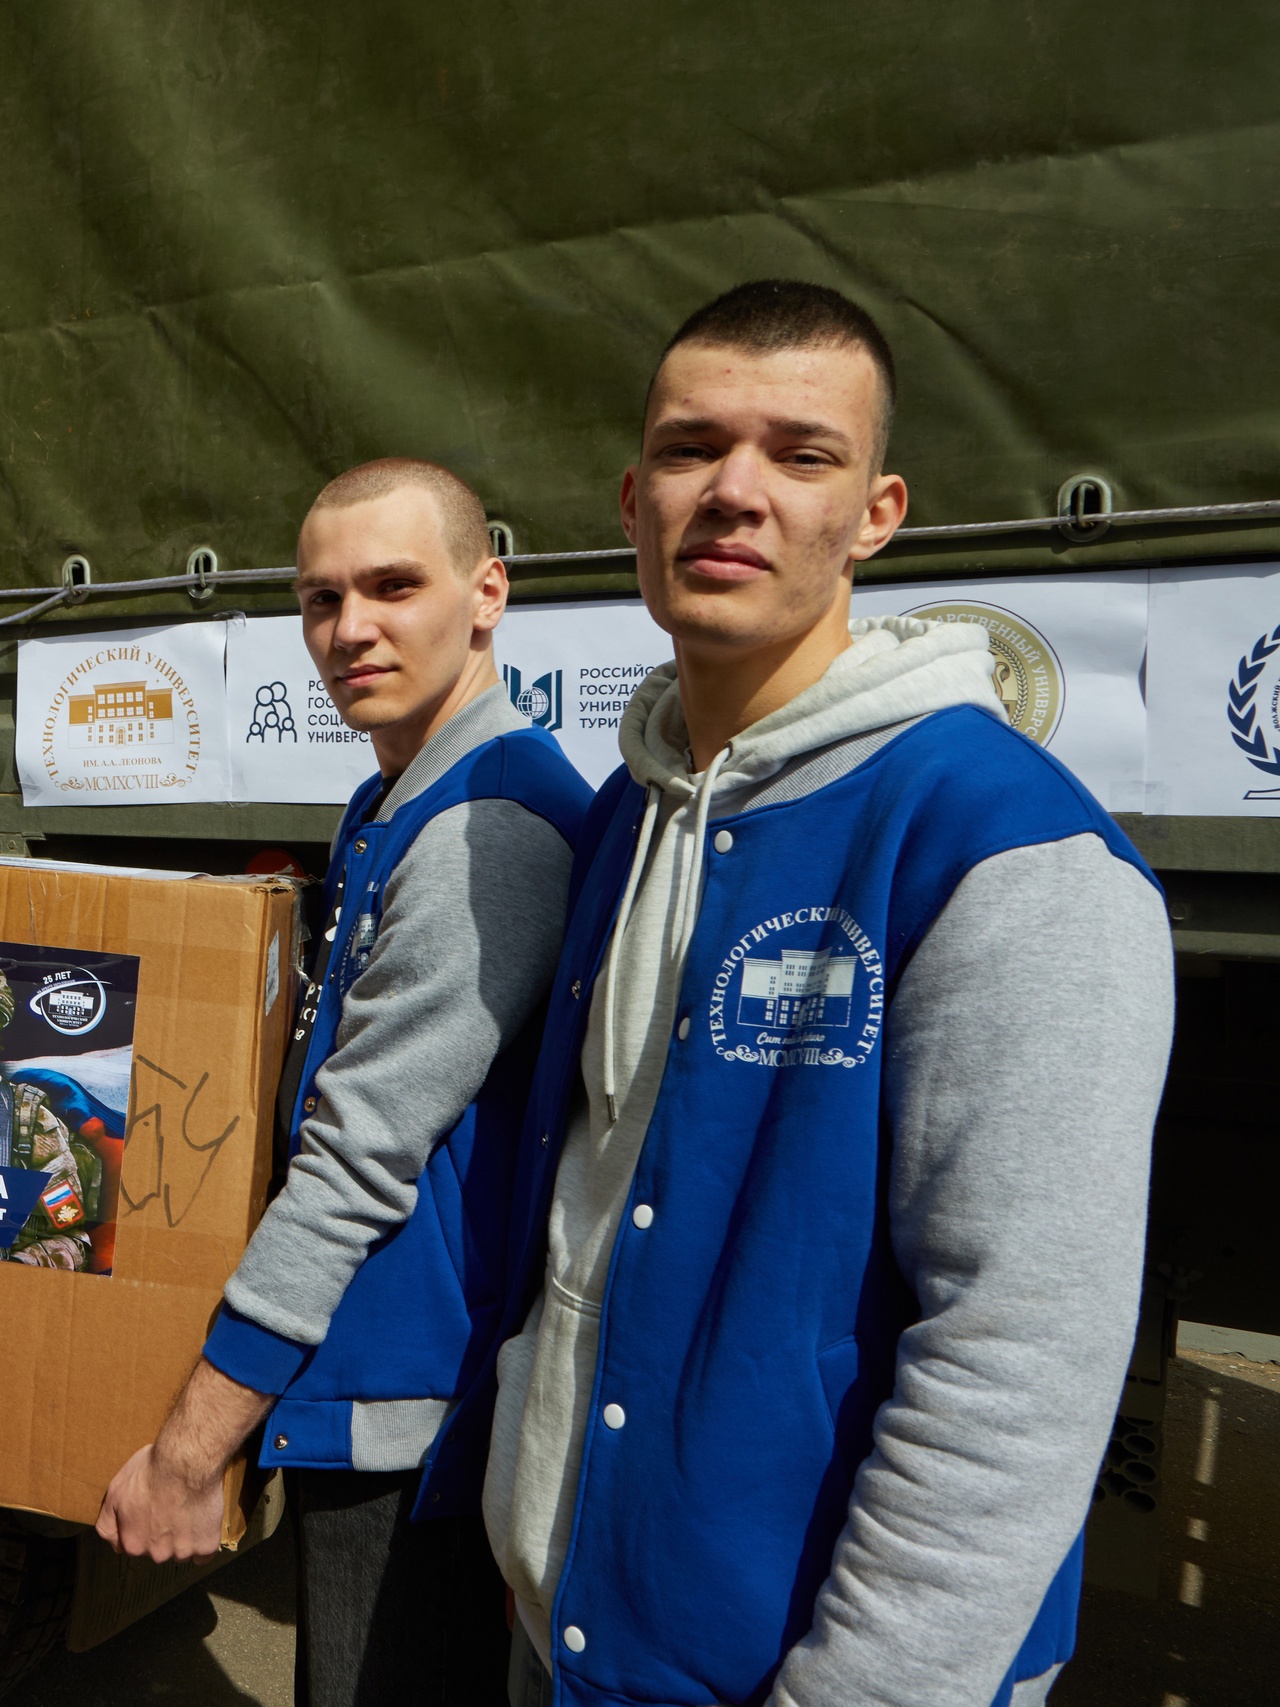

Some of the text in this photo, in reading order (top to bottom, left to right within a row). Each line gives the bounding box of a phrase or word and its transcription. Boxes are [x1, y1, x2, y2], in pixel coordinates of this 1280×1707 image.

[926, 613, 1049, 741] АРСТВЕННЫЙ УНИВЕРС
[42, 645, 201, 780] ТЕХНОЛОГИЧЕСКИЙ УНИВЕРСИТЕТ
[580, 718, 622, 729] ТУРИ
[308, 731, 372, 743] УНИВЕРС
[119, 757, 162, 766] ЛЕОНОВА
[84, 774, 159, 791] MCMXCVIII
[43, 971, 72, 985] 25 ЛЕТ
